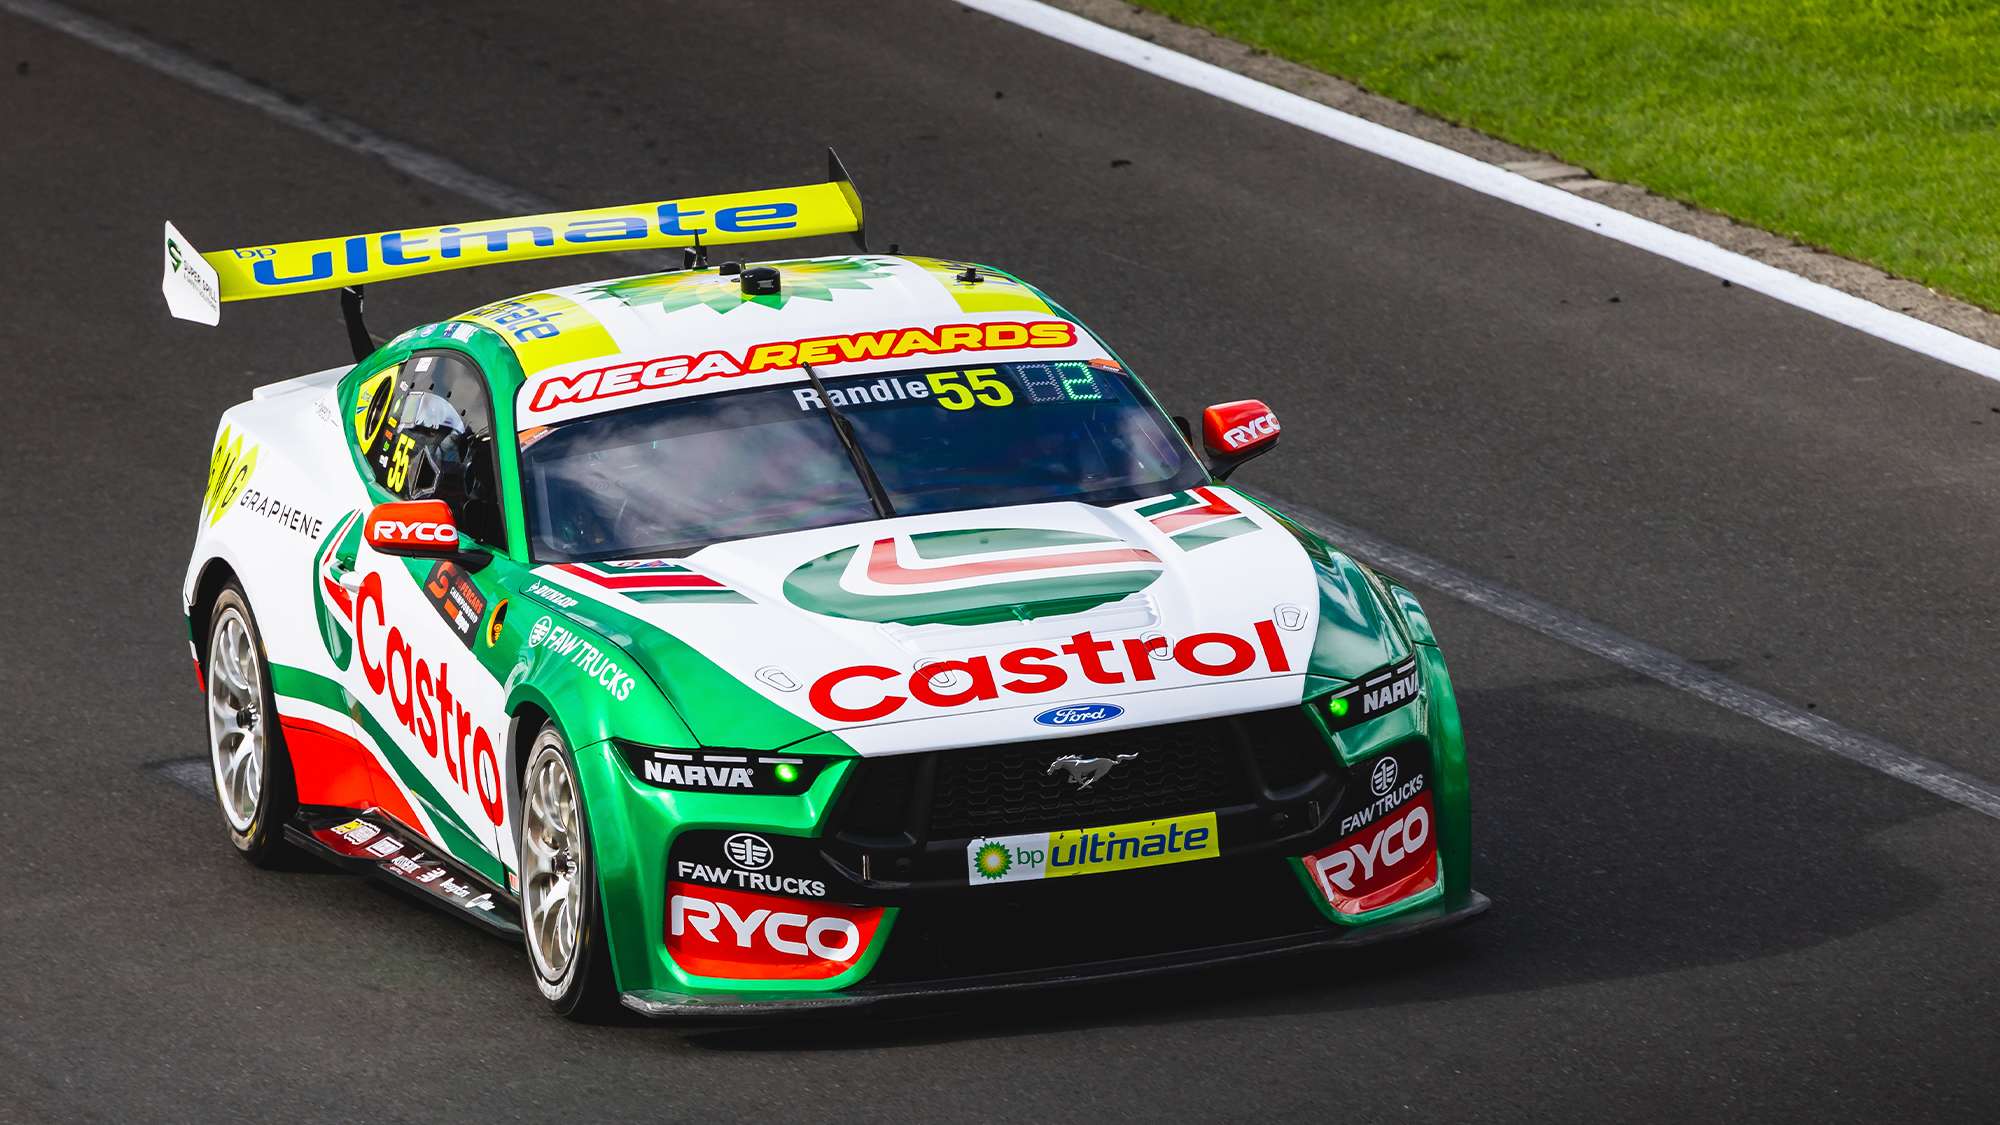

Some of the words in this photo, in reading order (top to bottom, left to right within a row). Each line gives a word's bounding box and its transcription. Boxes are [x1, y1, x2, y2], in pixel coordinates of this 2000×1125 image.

[233, 246, 277, 259] bp
[253, 203, 798, 286] ultimate
[533, 352, 742, 410] MEGA
[745, 323, 1073, 370] REWARDS
[793, 378, 930, 411] Randle
[925, 368, 1014, 411] 55
[1223, 412, 1280, 449] RYCO
[387, 433, 416, 493] 55
[240, 489, 323, 540] GRAPHENE
[373, 520, 457, 542] RYCO
[536, 584, 580, 608] DUNLOP
[544, 624, 582, 662] FAW
[570, 645, 635, 701] TRUCKS
[808, 619, 1291, 723] Castrol
[1052, 706, 1107, 724] Ford
[644, 760, 753, 788] NARVA
[1340, 809, 1375, 835] FAW
[1374, 774, 1424, 816] TRUCKS
[1016, 847, 1044, 868] bp
[1051, 822, 1209, 867] ultimate
[1316, 806, 1430, 901] RYCO
[678, 860, 731, 884] FAW
[733, 870, 826, 896] TRUCKS
[671, 894, 860, 962] RYCO
